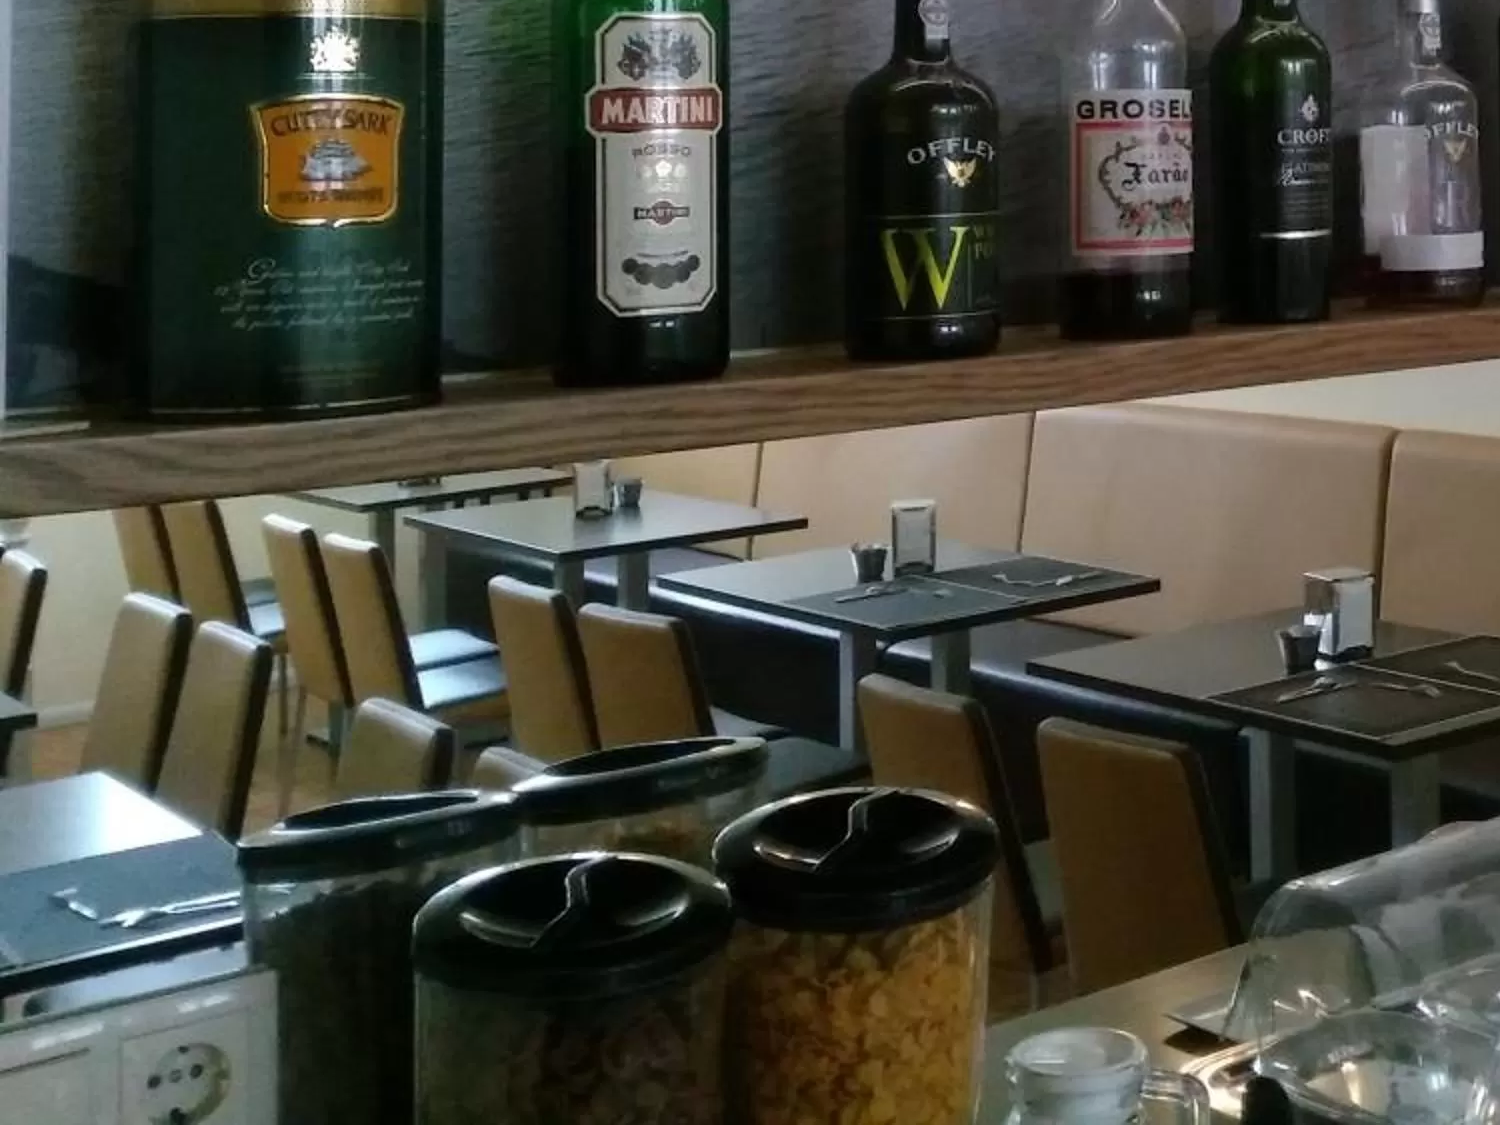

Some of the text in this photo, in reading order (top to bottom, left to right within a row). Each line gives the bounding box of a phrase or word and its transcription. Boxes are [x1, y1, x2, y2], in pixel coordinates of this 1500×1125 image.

[342, 108, 393, 137] SARK
[602, 95, 714, 125] MARTINI
[1076, 98, 1193, 120] GROSEL
[632, 144, 692, 159] ROSSO
[881, 225, 970, 312] W
